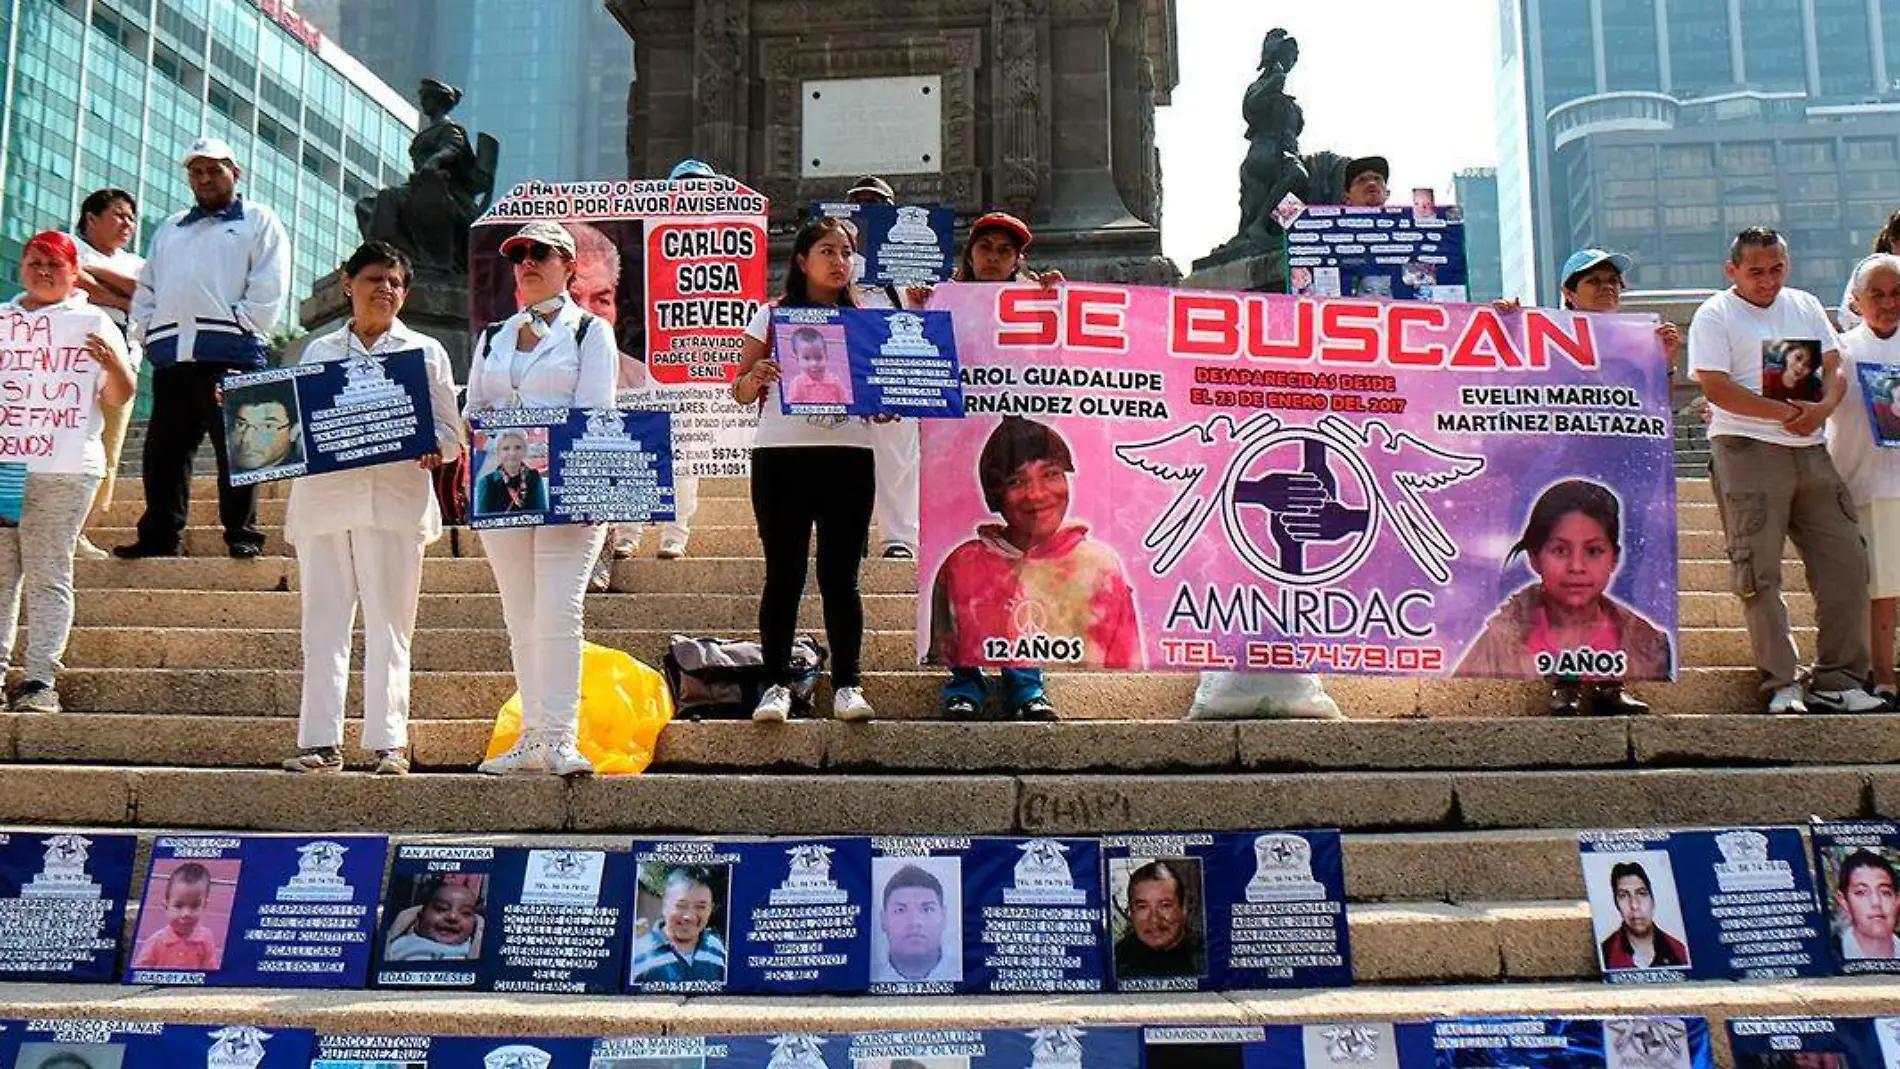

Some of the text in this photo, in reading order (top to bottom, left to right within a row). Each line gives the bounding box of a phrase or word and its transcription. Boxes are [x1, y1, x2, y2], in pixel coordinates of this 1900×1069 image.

[634, 180, 677, 194] SABE
[684, 180, 708, 192] DE
[714, 179, 736, 192] SU
[574, 198, 607, 214] POR
[615, 197, 669, 212] FAVOR
[676, 197, 762, 212] AVISENOS
[665, 230, 753, 257] CARLOS
[678, 265, 739, 291] SOSA
[997, 288, 1597, 367] SE BUSCAN
[671, 337, 744, 349] EXTRAVIADO
[654, 353, 697, 363] PADECE
[689, 367, 724, 377] SENIL
[1025, 369, 1162, 391] GUADALUPE
[1195, 368, 1396, 392] DESAPARECIDAS DESDE
[1080, 397, 1169, 420] OLVERA
[1191, 388, 1407, 413] EL 23 DE ENERO DEL 2017
[1463, 387, 1641, 409] EVELIN MARISOL
[1437, 411, 1665, 436] MARTÍNEZ BALTAZAR
[692, 463, 746, 475] 5113-1091
[1165, 585, 1434, 637] AMNRDAC
[986, 634, 1082, 661] 12 AÑOS
[1161, 641, 1442, 670] TEL. 56.74.79.02
[1538, 648, 1626, 677] 9 AÑOS
[426, 847, 493, 859] ALCANTARA
[27, 1021, 164, 1034] FRANCISCO SALINAS
[320, 1036, 430, 1048] MARCO ANTONIO
